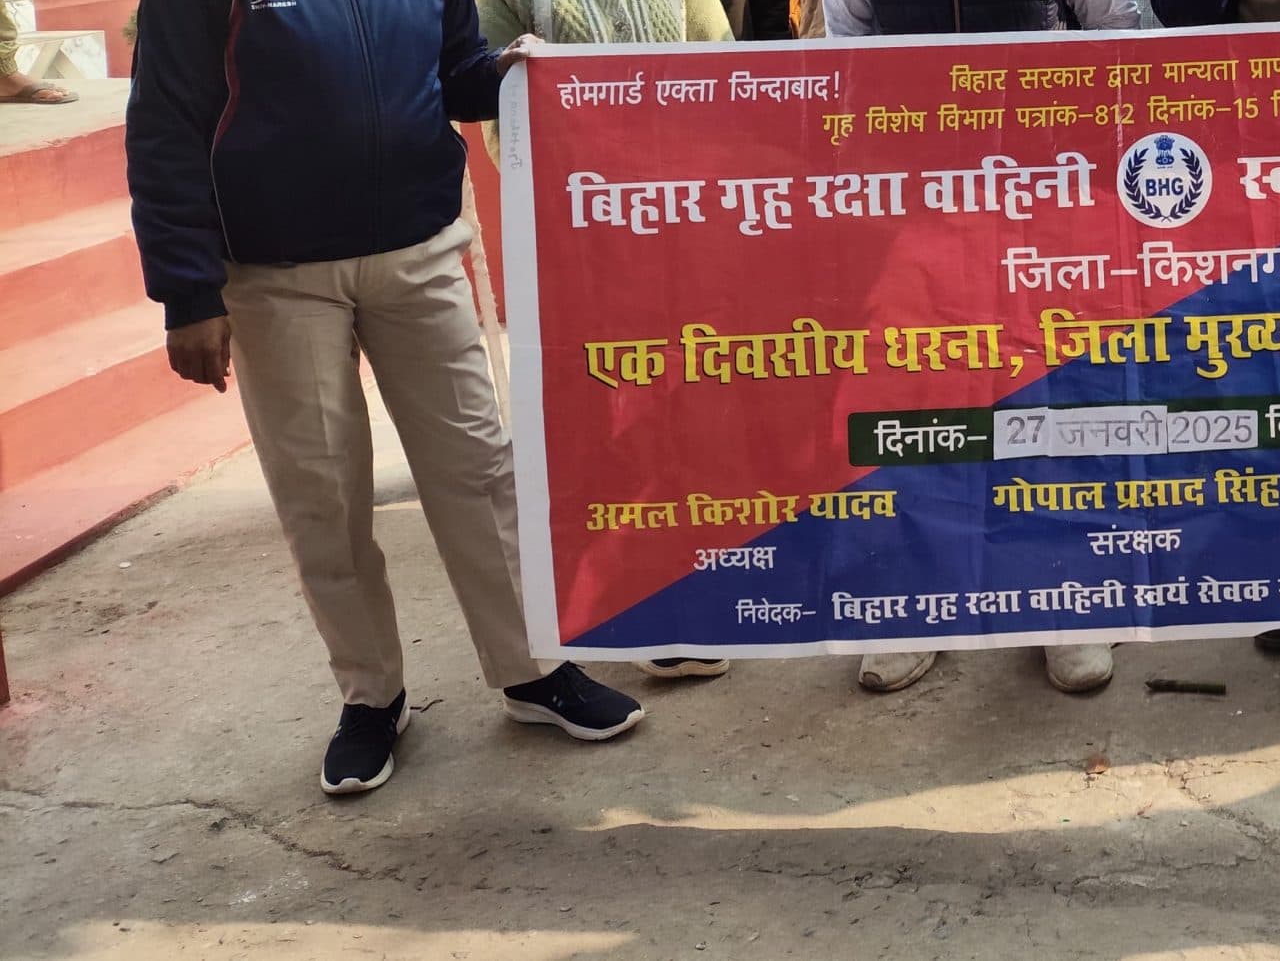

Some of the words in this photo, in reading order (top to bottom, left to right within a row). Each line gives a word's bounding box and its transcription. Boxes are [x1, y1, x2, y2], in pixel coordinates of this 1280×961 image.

[557, 71, 645, 109] होमगार्ड
[656, 78, 716, 105] एक्ता
[728, 70, 842, 104] जिन्दाबाद!
[950, 64, 1006, 94] बिहार
[1018, 65, 1096, 91] सरकार
[1107, 61, 1152, 90] द्वारा
[1162, 59, 1239, 84] मान्यता
[822, 111, 855, 143] गृह
[866, 104, 925, 135] विशेष
[937, 104, 1004, 132] विभाग
[566, 171, 706, 236] बिहार
[717, 175, 794, 237] गृह
[806, 171, 908, 220] रक्षा
[921, 151, 1097, 222] वाहिनी
[1145, 177, 1184, 197] BHG
[584, 338, 668, 388] एक
[680, 317, 870, 384] दिवसीय
[884, 323, 1024, 378] धरना,
[1040, 308, 1171, 367] जिला
[1006, 415, 1046, 445] 27
[1055, 409, 1163, 447] जनवरी
[1171, 415, 1252, 444] 2025
[586, 500, 679, 531] अमल
[686, 490, 800, 527] किशोर
[807, 489, 897, 520] यादव
[992, 477, 1105, 513] गोपाल
[1116, 479, 1207, 509] प्रसाद
[692, 545, 777, 573] अध्यक्ष
[1087, 527, 1183, 556] संरक्षक
[831, 590, 907, 624] बिहार
[916, 592, 958, 624] गृह
[965, 589, 1021, 616] रक्षा
[1029, 581, 1126, 616] वाहिनी
[1133, 580, 1190, 609] स्वयं
[1198, 575, 1271, 605] सेवक
